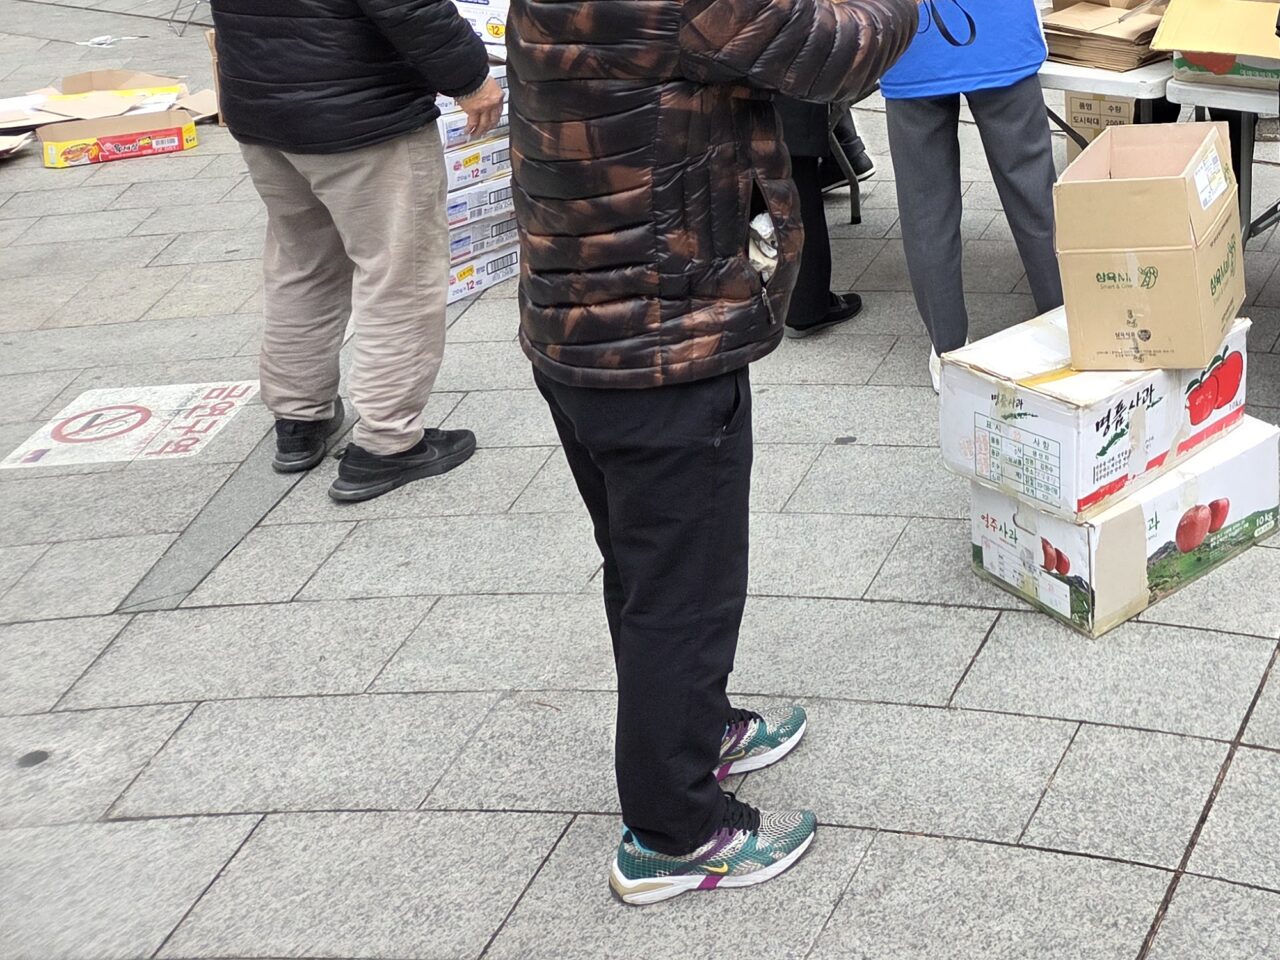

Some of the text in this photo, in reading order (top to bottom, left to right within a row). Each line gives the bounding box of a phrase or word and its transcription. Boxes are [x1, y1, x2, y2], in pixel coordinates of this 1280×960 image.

[471, 168, 479, 179] 12
[466, 280, 475, 291] 12
[1096, 384, 1157, 438] 명품사과
[145, 385, 253, 456] 금연구역
[1256, 511, 1274, 527] 10kg
